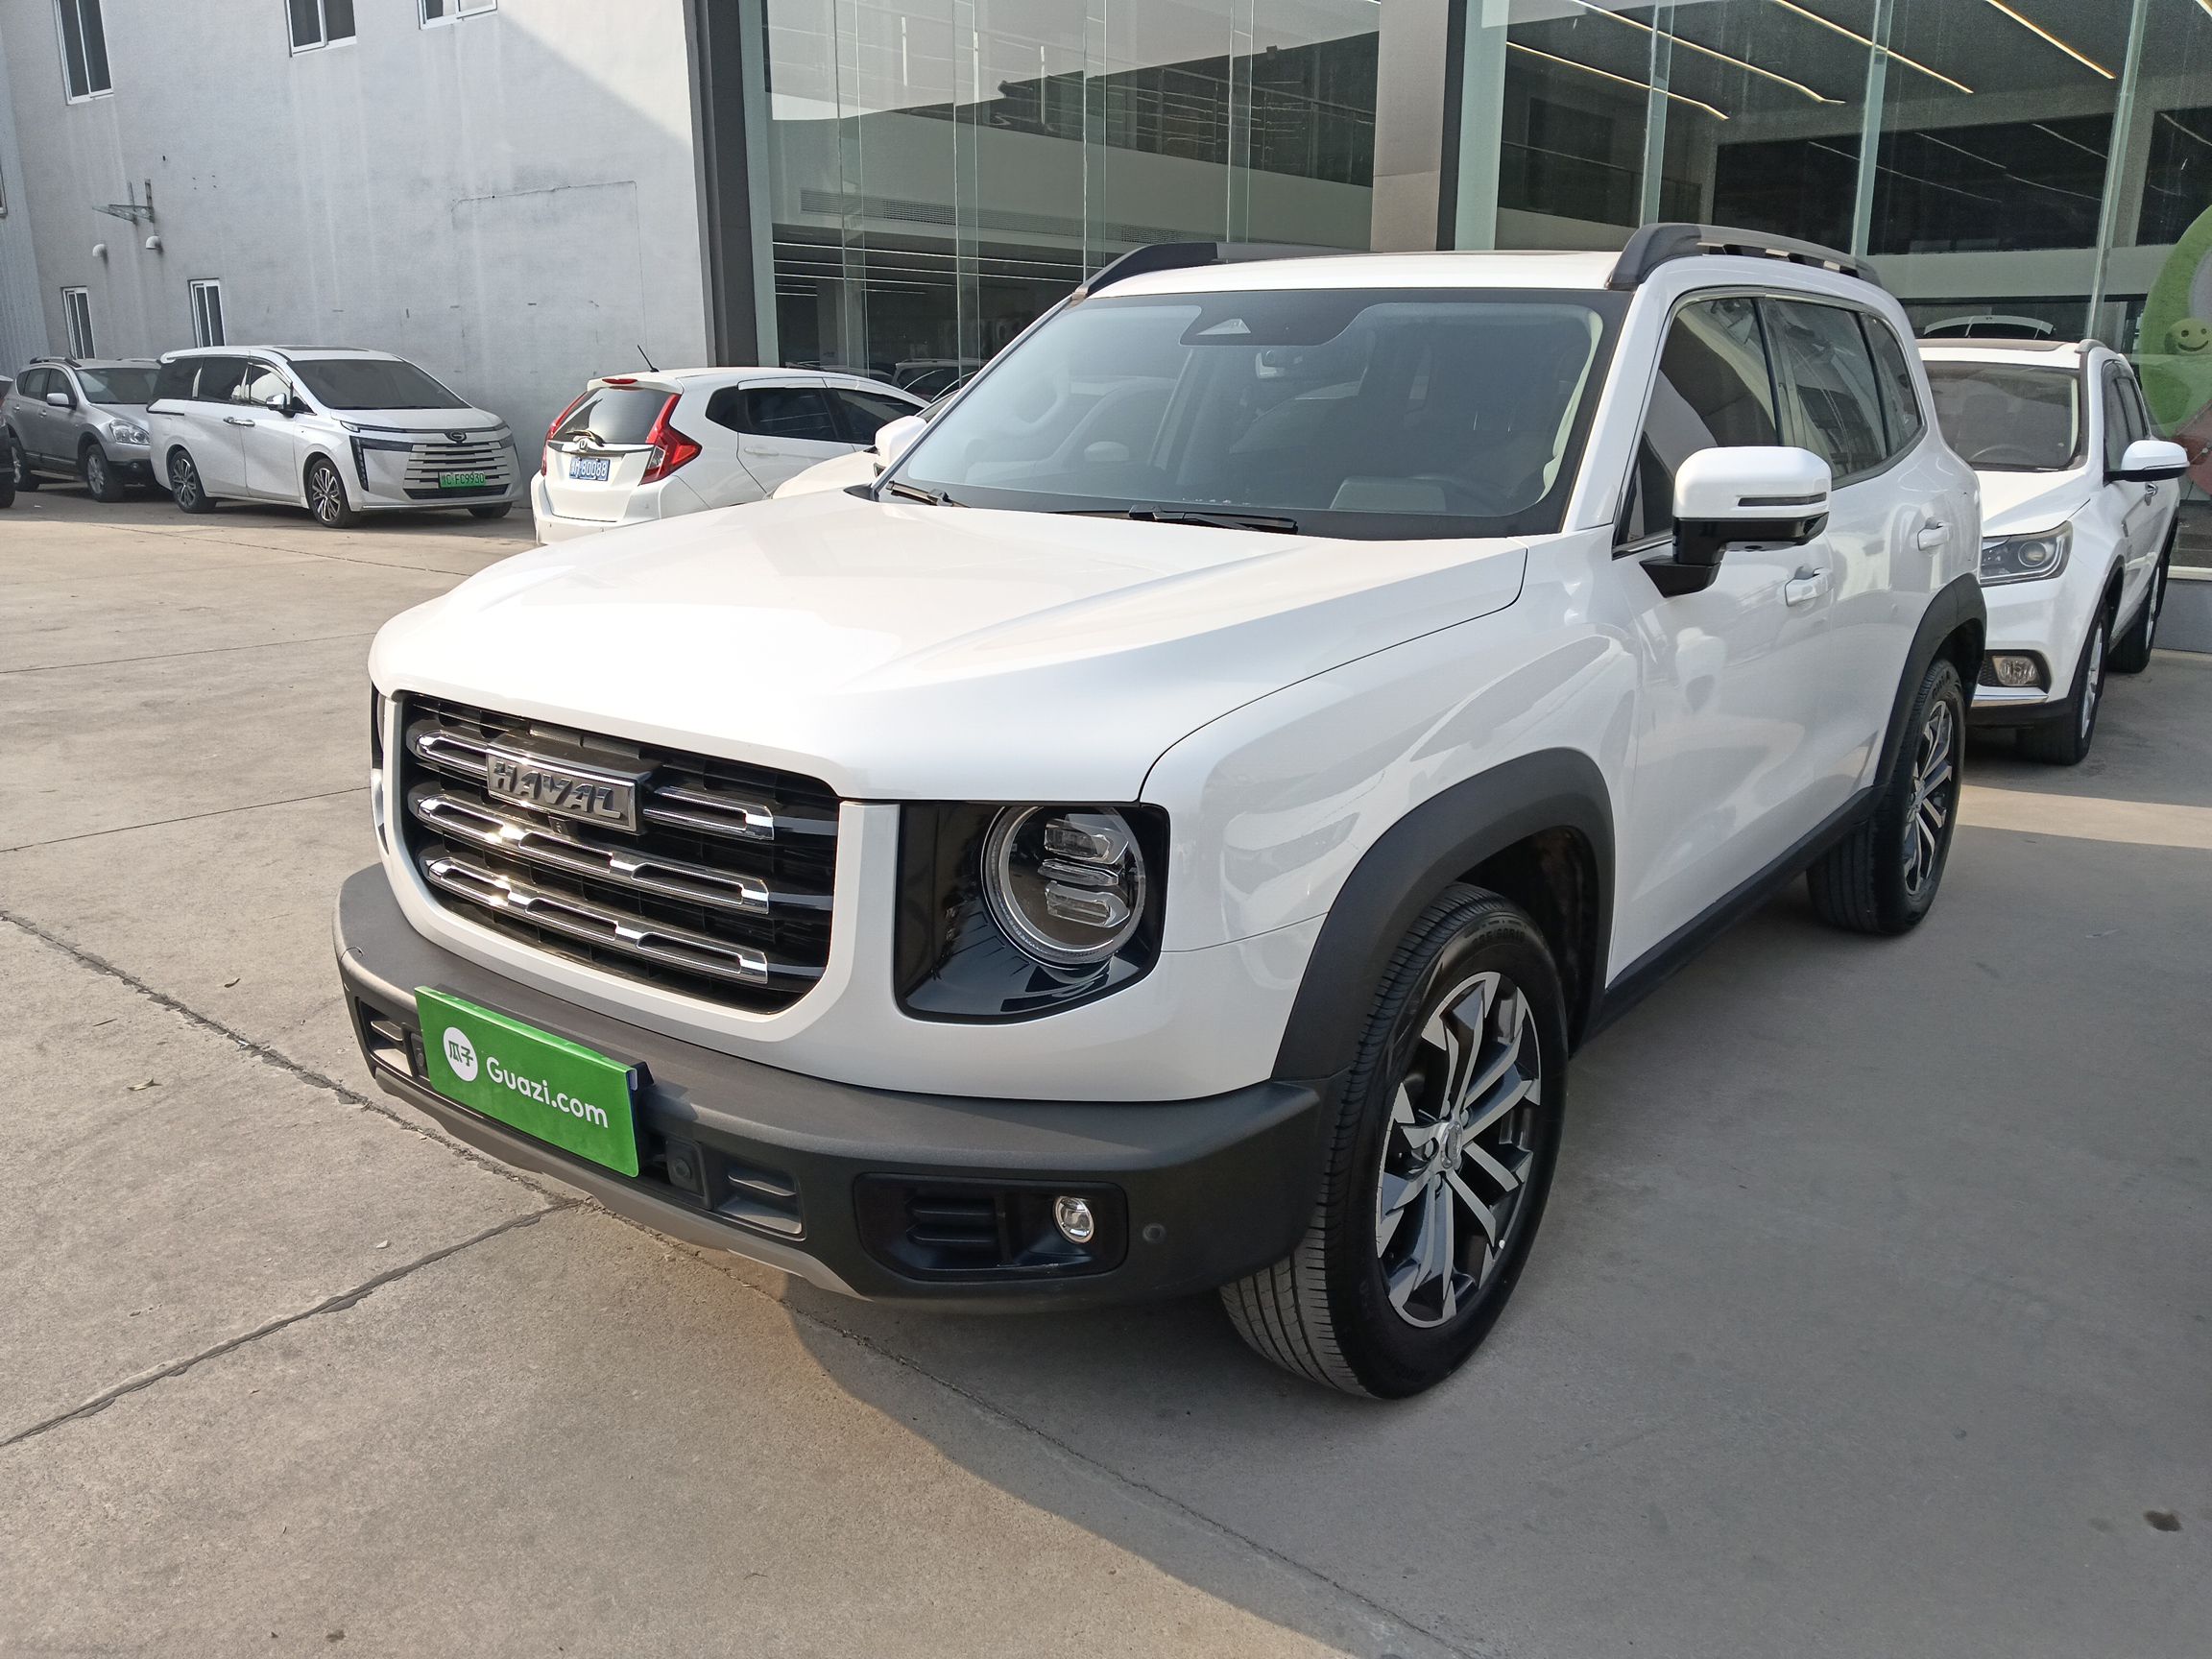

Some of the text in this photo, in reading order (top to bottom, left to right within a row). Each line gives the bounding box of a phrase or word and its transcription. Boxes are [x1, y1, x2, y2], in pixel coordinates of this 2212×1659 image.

[493, 760, 622, 819] HAVAL
[447, 1040, 473, 1067] 瓜子
[486, 1056, 609, 1128] Guazi.com
